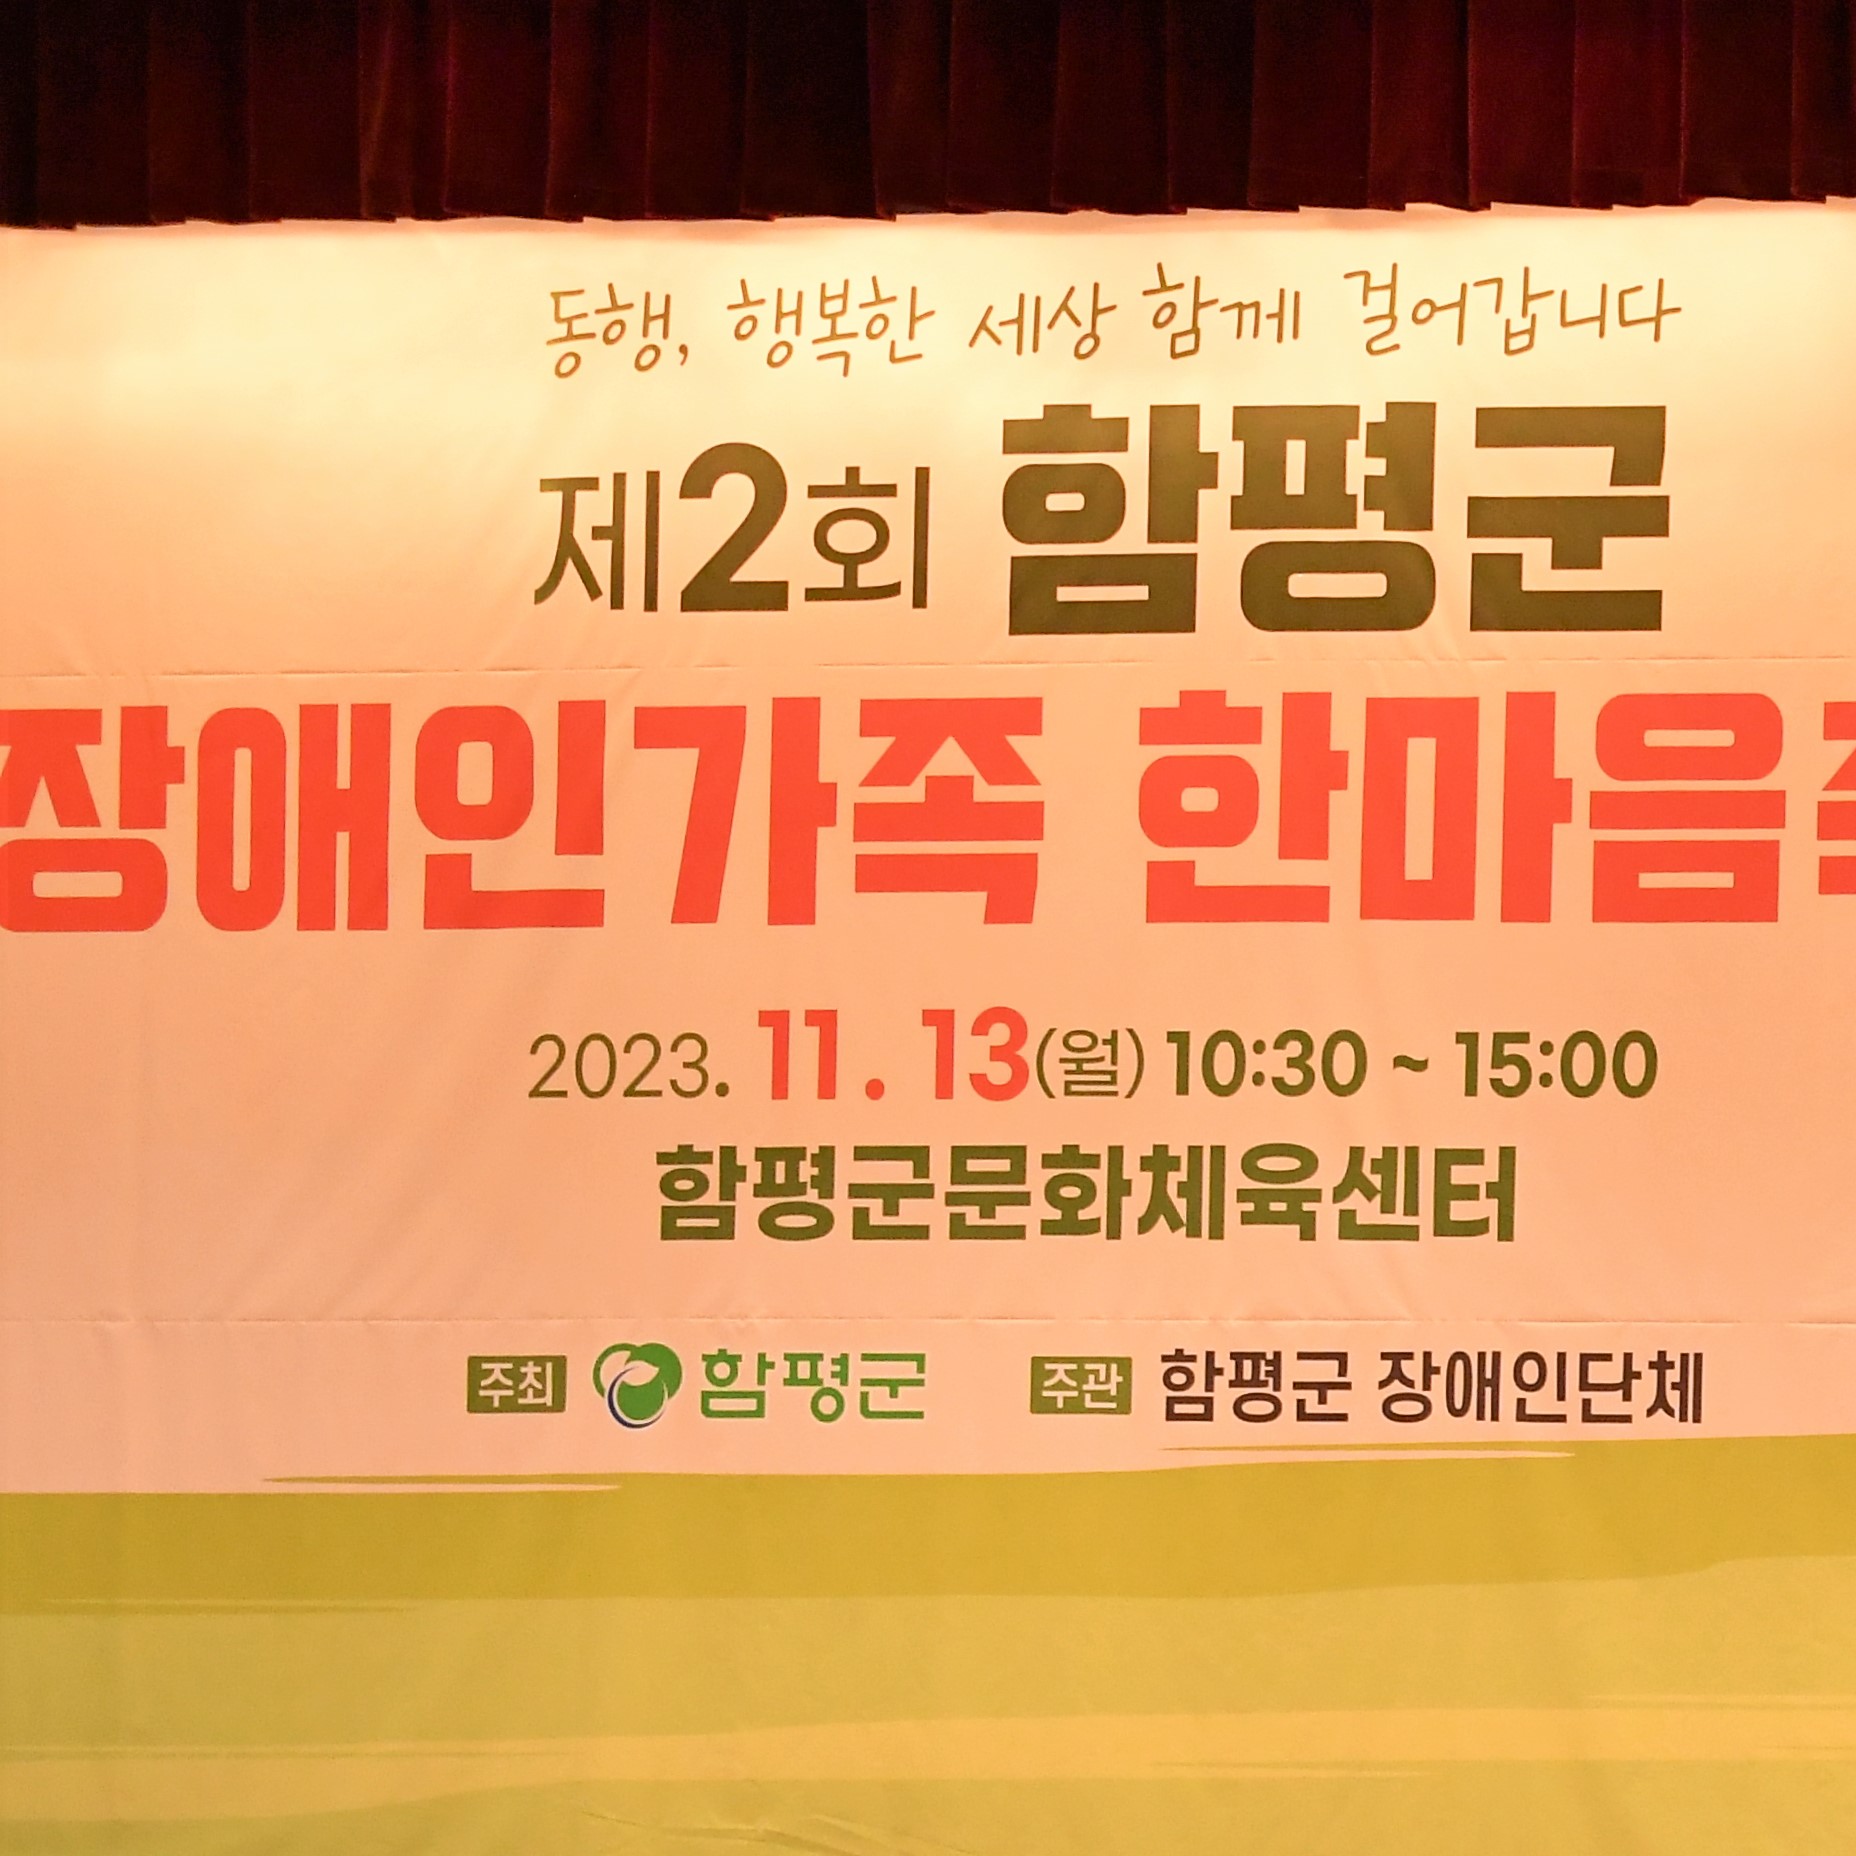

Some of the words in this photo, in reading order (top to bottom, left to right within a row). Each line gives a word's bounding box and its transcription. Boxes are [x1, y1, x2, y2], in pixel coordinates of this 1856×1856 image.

[546, 276, 690, 379] 동행,
[727, 275, 936, 377] 행복한
[968, 282, 1118, 360] 세상
[1141, 262, 1301, 360] 함께
[1342, 262, 1683, 356] 걸어갑니다
[534, 442, 931, 613] 제2회
[1002, 402, 1670, 636] 함평군
[0, 696, 1045, 933] 장애인가족
[527, 1031, 731, 1100] 2023.
[1165, 1028, 1369, 1098] 10:30
[1453, 1029, 1659, 1099] 15:00
[656, 1142, 1517, 1243] 함평군문화체육센터
[480, 1362, 555, 1409] 주최
[699, 1348, 927, 1424] 함평군
[1040, 1362, 1124, 1409] 주관
[1159, 1347, 1353, 1424] 함평군
[1375, 1346, 1704, 1425] 장애인단체
